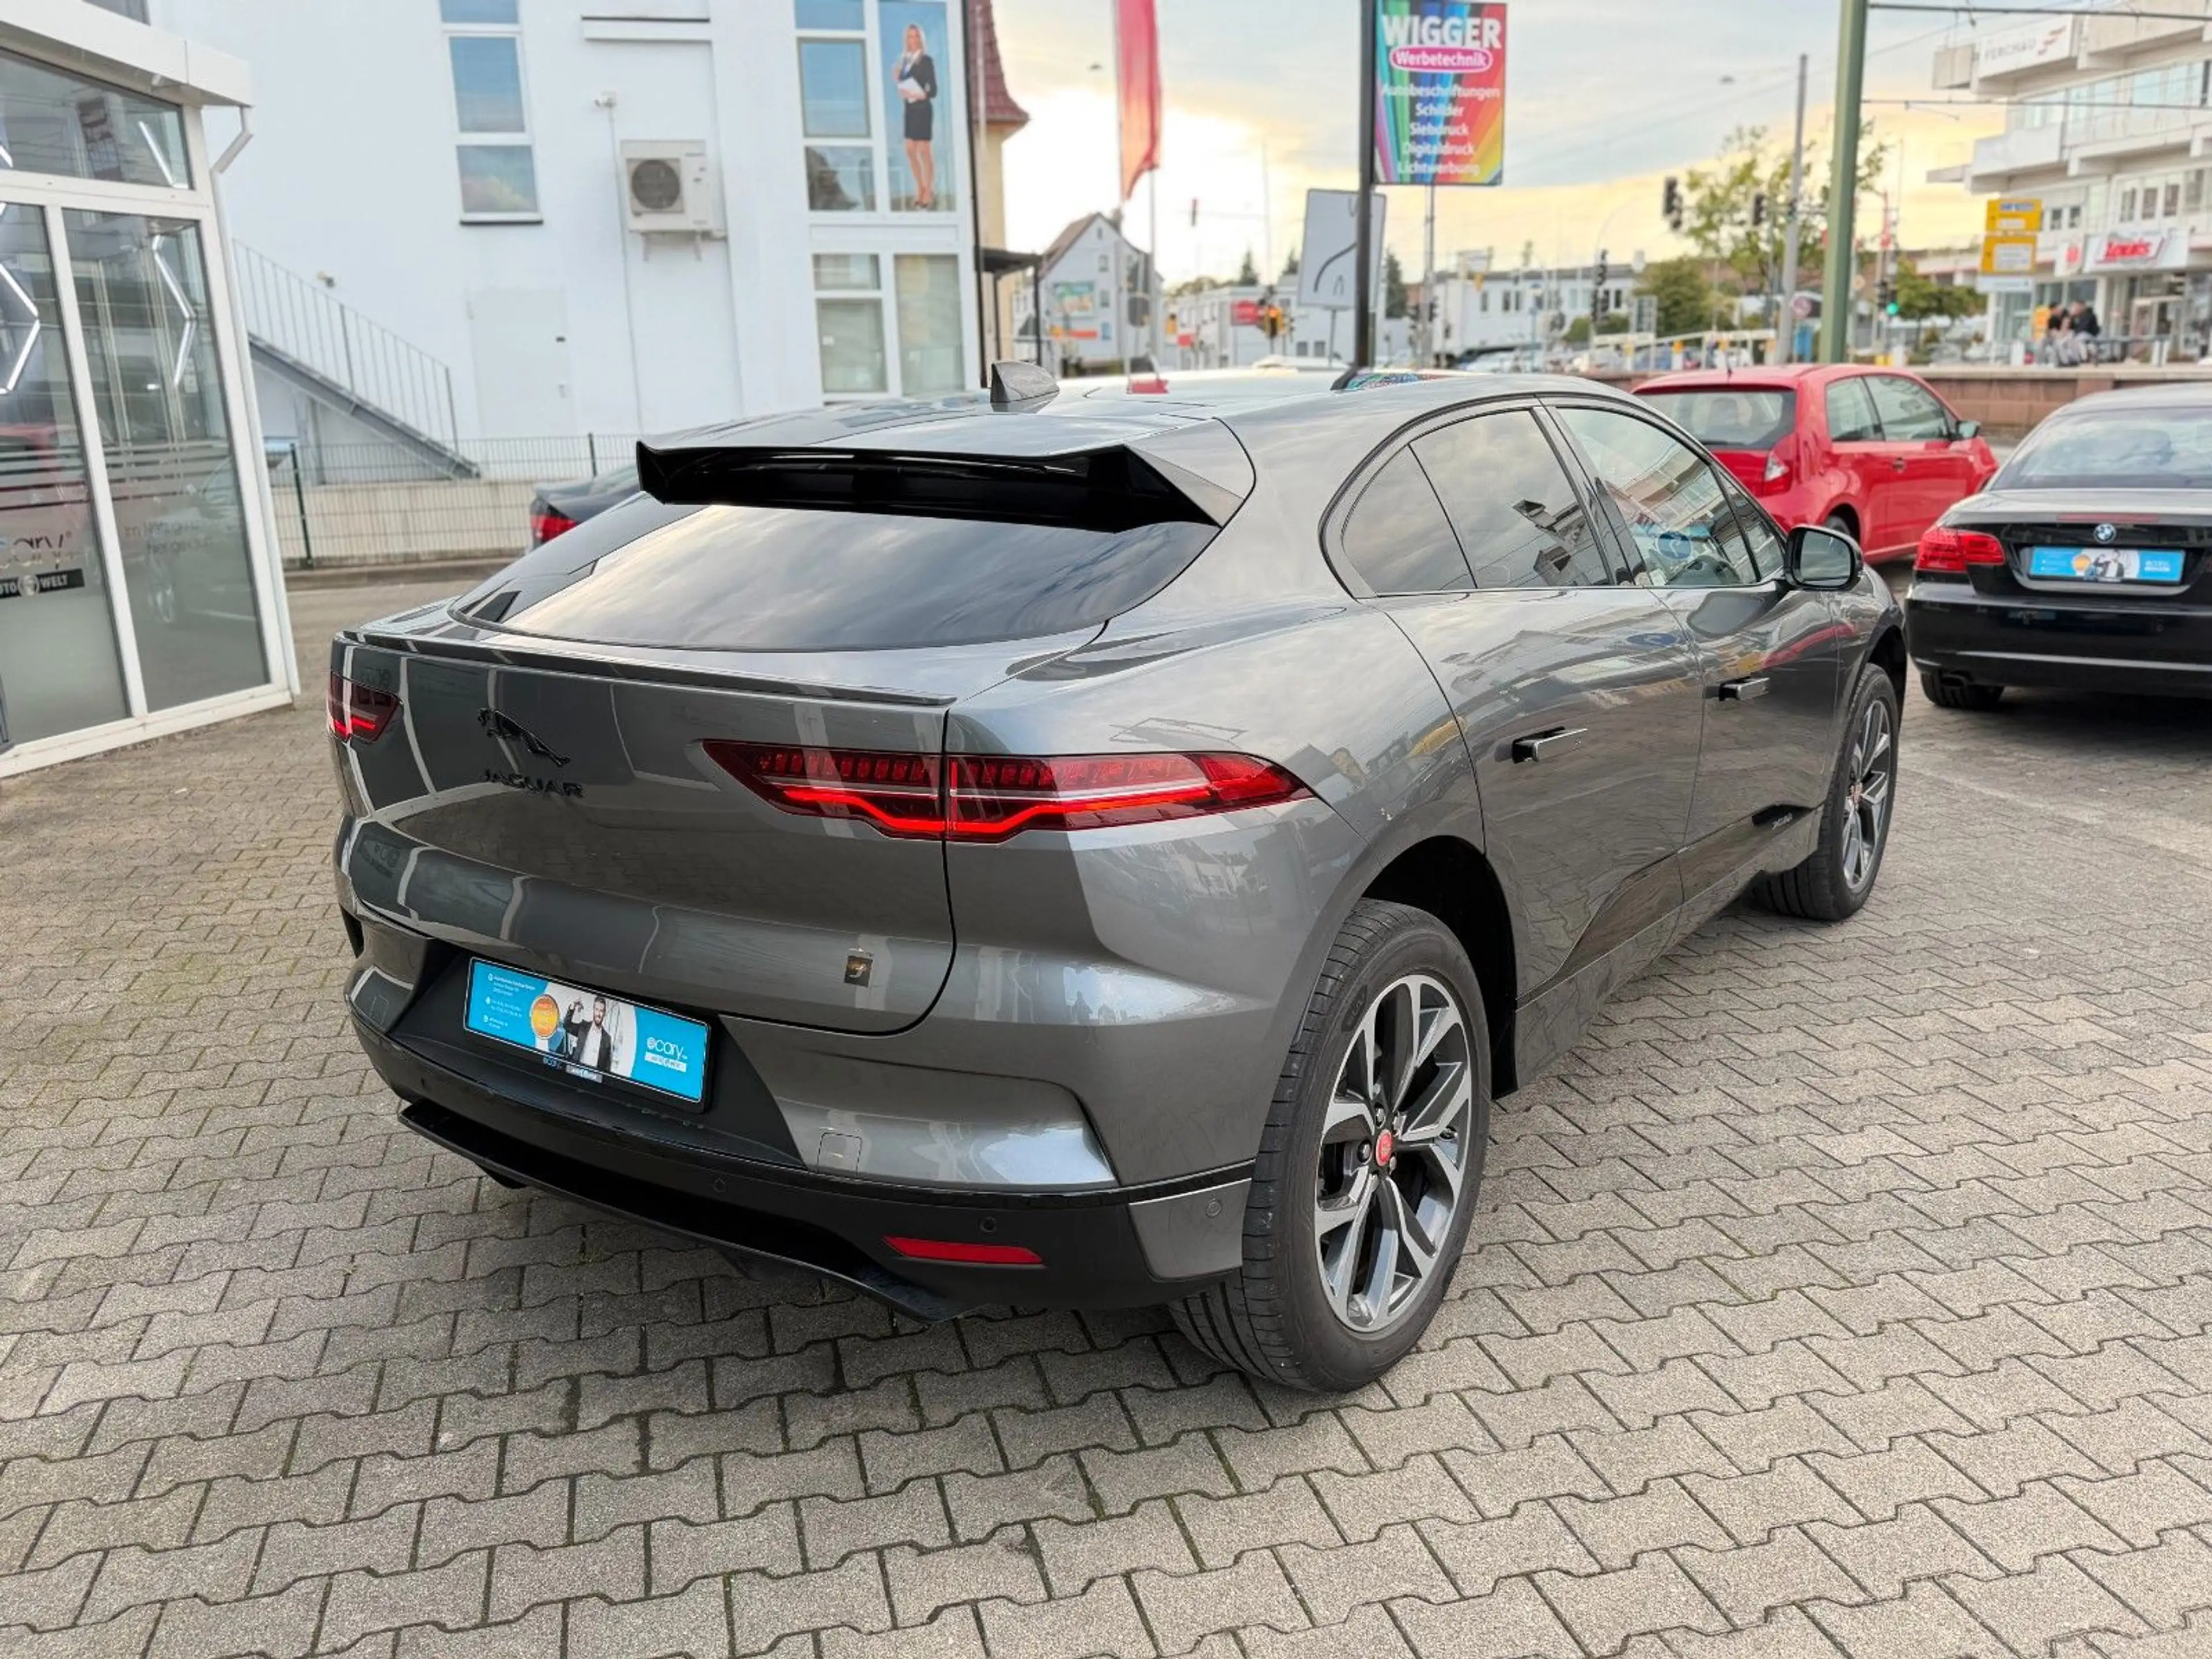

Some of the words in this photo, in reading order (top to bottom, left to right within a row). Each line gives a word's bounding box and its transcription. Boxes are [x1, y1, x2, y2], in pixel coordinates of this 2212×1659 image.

[1381, 14, 1502, 49] WIGGER
[1395, 51, 1487, 67] Werbetechnik
[1382, 84, 1501, 101] Autobeschriftungen
[1415, 103, 1464, 116] Schilder
[1410, 122, 1469, 135] Siebdruck
[1402, 142, 1474, 158] Digitaldruck
[1397, 160, 1480, 176] Lichtwerbung
[40, 574, 68, 589] WELT
